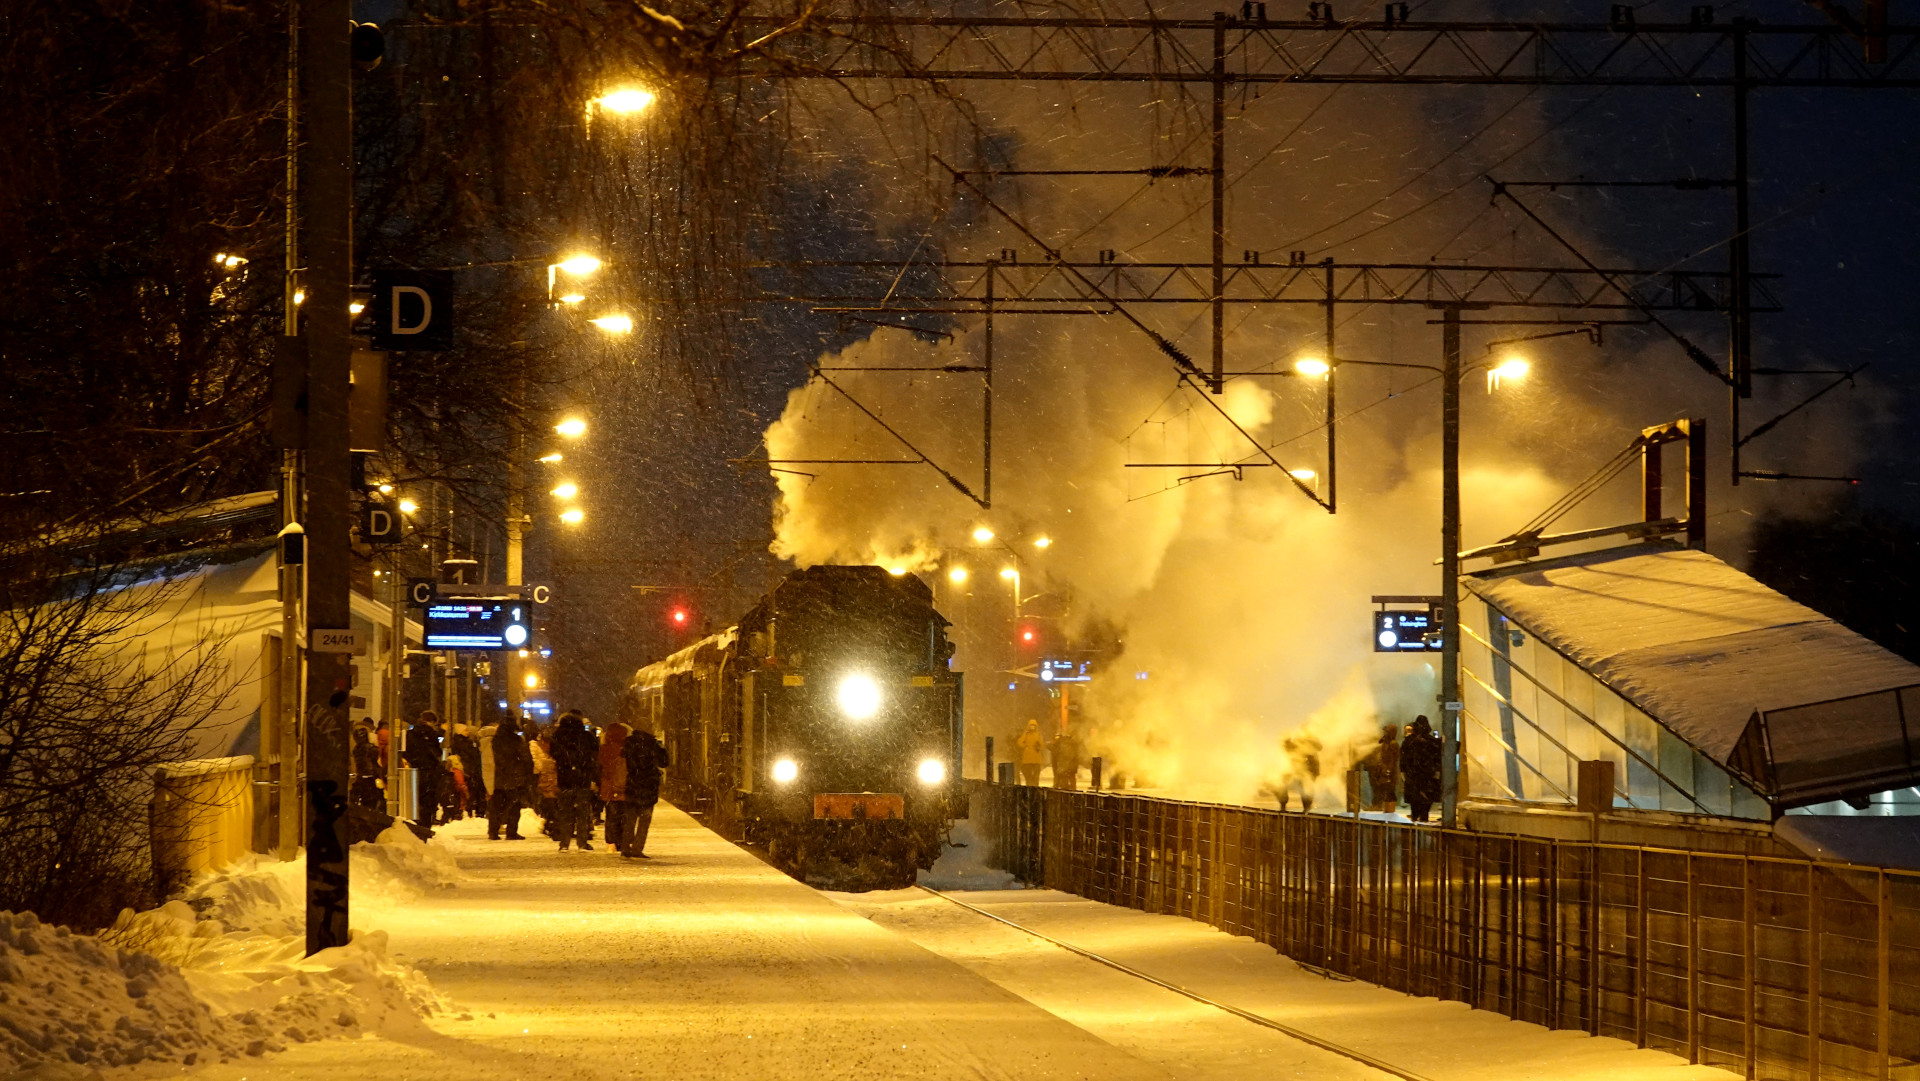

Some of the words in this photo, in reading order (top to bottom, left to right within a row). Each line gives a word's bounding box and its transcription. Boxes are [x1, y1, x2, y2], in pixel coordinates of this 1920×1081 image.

[391, 286, 432, 335] D
[370, 510, 392, 536] D
[413, 583, 430, 603] C
[533, 586, 550, 603] C
[511, 608, 521, 621] 1
[1384, 617, 1393, 629] 2
[322, 634, 354, 646] 24/41
